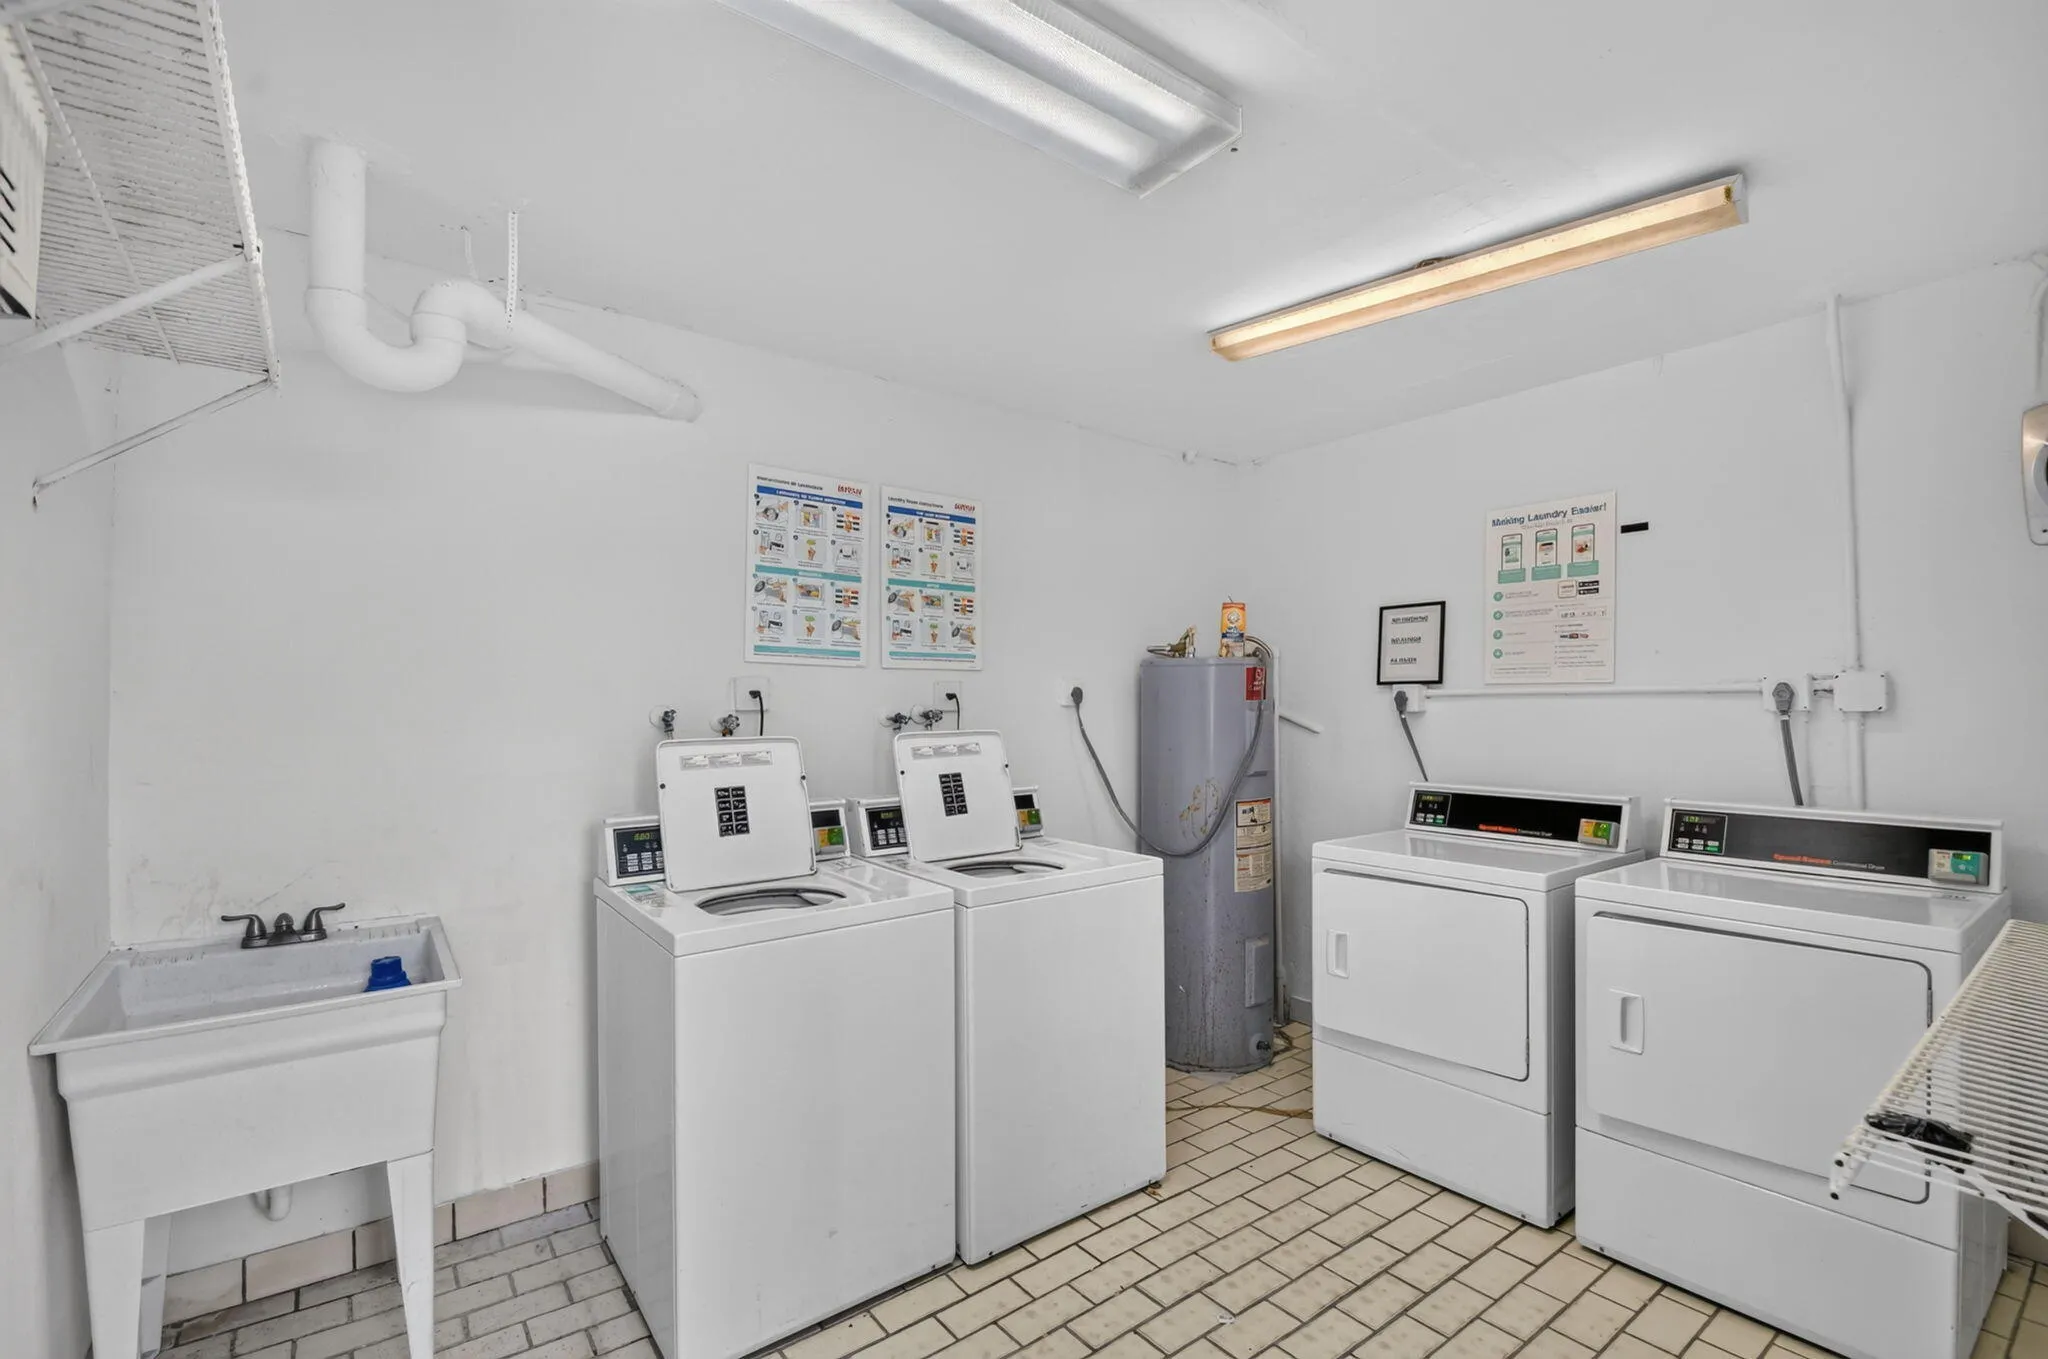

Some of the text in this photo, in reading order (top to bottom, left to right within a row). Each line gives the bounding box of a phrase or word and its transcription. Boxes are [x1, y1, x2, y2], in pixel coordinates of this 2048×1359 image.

[1492, 515, 1525, 527] Making
[1528, 509, 1568, 522] Laundry
[1571, 502, 1607, 516] Easier!
